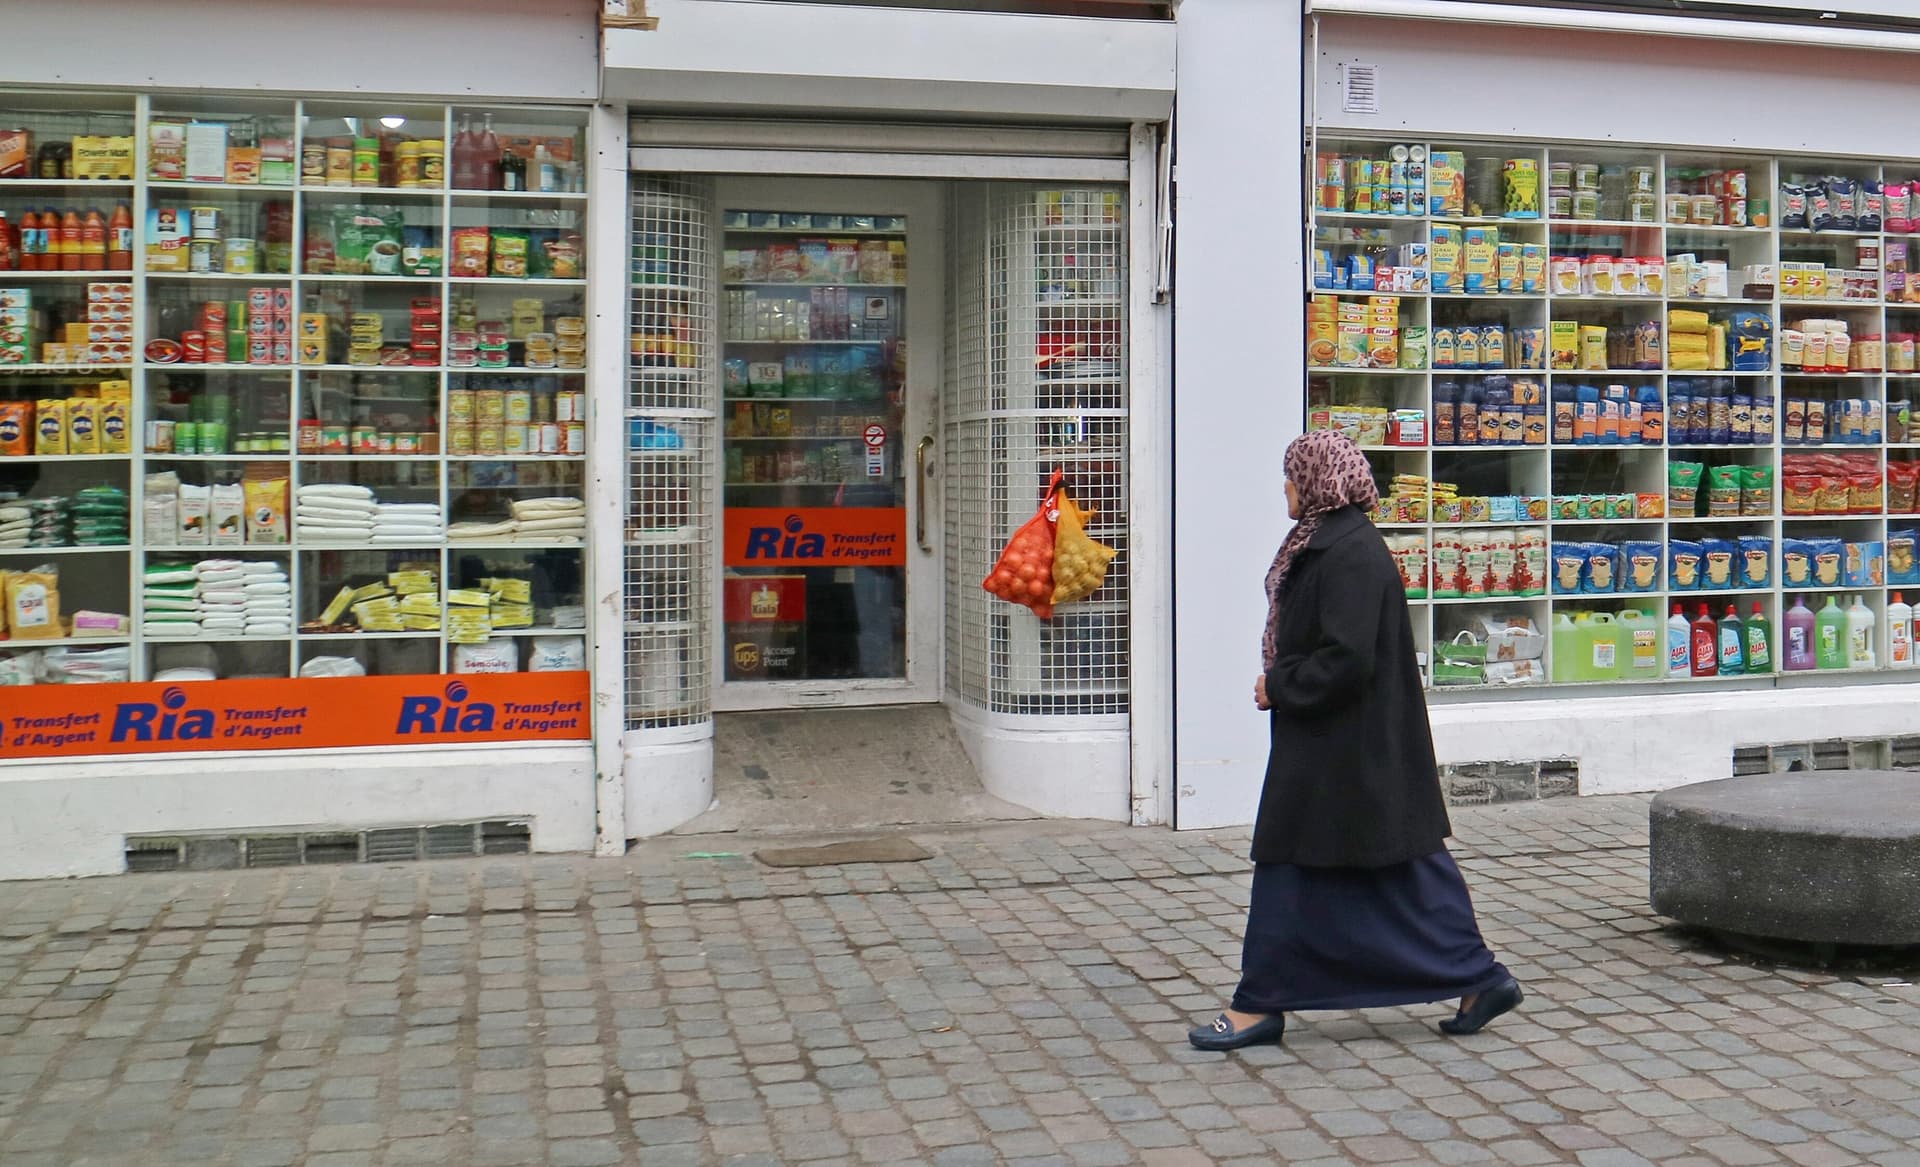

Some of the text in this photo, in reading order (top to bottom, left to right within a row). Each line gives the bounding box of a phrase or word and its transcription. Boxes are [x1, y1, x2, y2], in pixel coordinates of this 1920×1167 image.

[744, 514, 826, 559] Ria
[832, 532, 896, 544] Transfert
[832, 547, 892, 559] d'Argent
[762, 646, 796, 656] Access
[1671, 645, 1687, 657] AJAX
[1697, 644, 1713, 657] AJAX
[1723, 645, 1738, 657] AJAX
[1750, 642, 1766, 653] AJAX
[735, 651, 758, 667] ups
[762, 656, 789, 667] Point
[109, 686, 215, 742] Ria
[223, 705, 307, 722] Transfert
[396, 680, 496, 734] Ria
[503, 700, 582, 715] Transfert
[13, 712, 101, 731] Transfert
[503, 717, 577, 733] d'Argent
[13, 730, 96, 747] d'Argent
[223, 723, 302, 739] d'Argent
